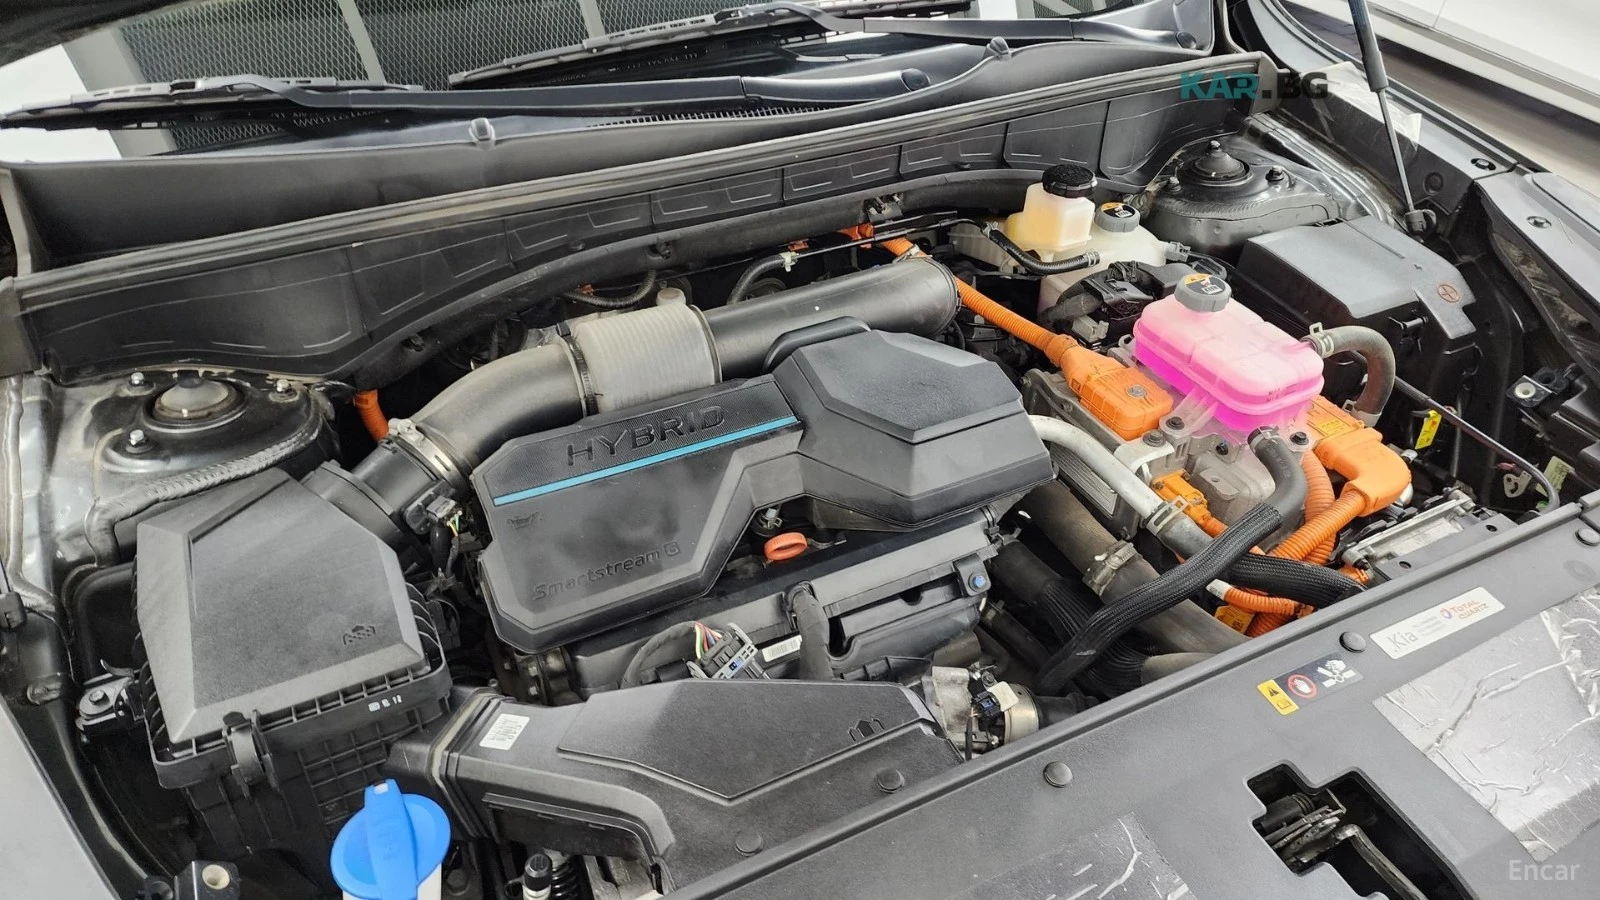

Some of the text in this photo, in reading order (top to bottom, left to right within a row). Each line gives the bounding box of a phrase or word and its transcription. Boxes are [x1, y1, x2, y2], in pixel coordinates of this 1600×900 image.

[567, 405, 725, 466] HYBRID
[533, 550, 660, 600] Smartstream
[1450, 600, 1480, 614] TOTAL
[1458, 603, 1489, 620] QUARTZ
